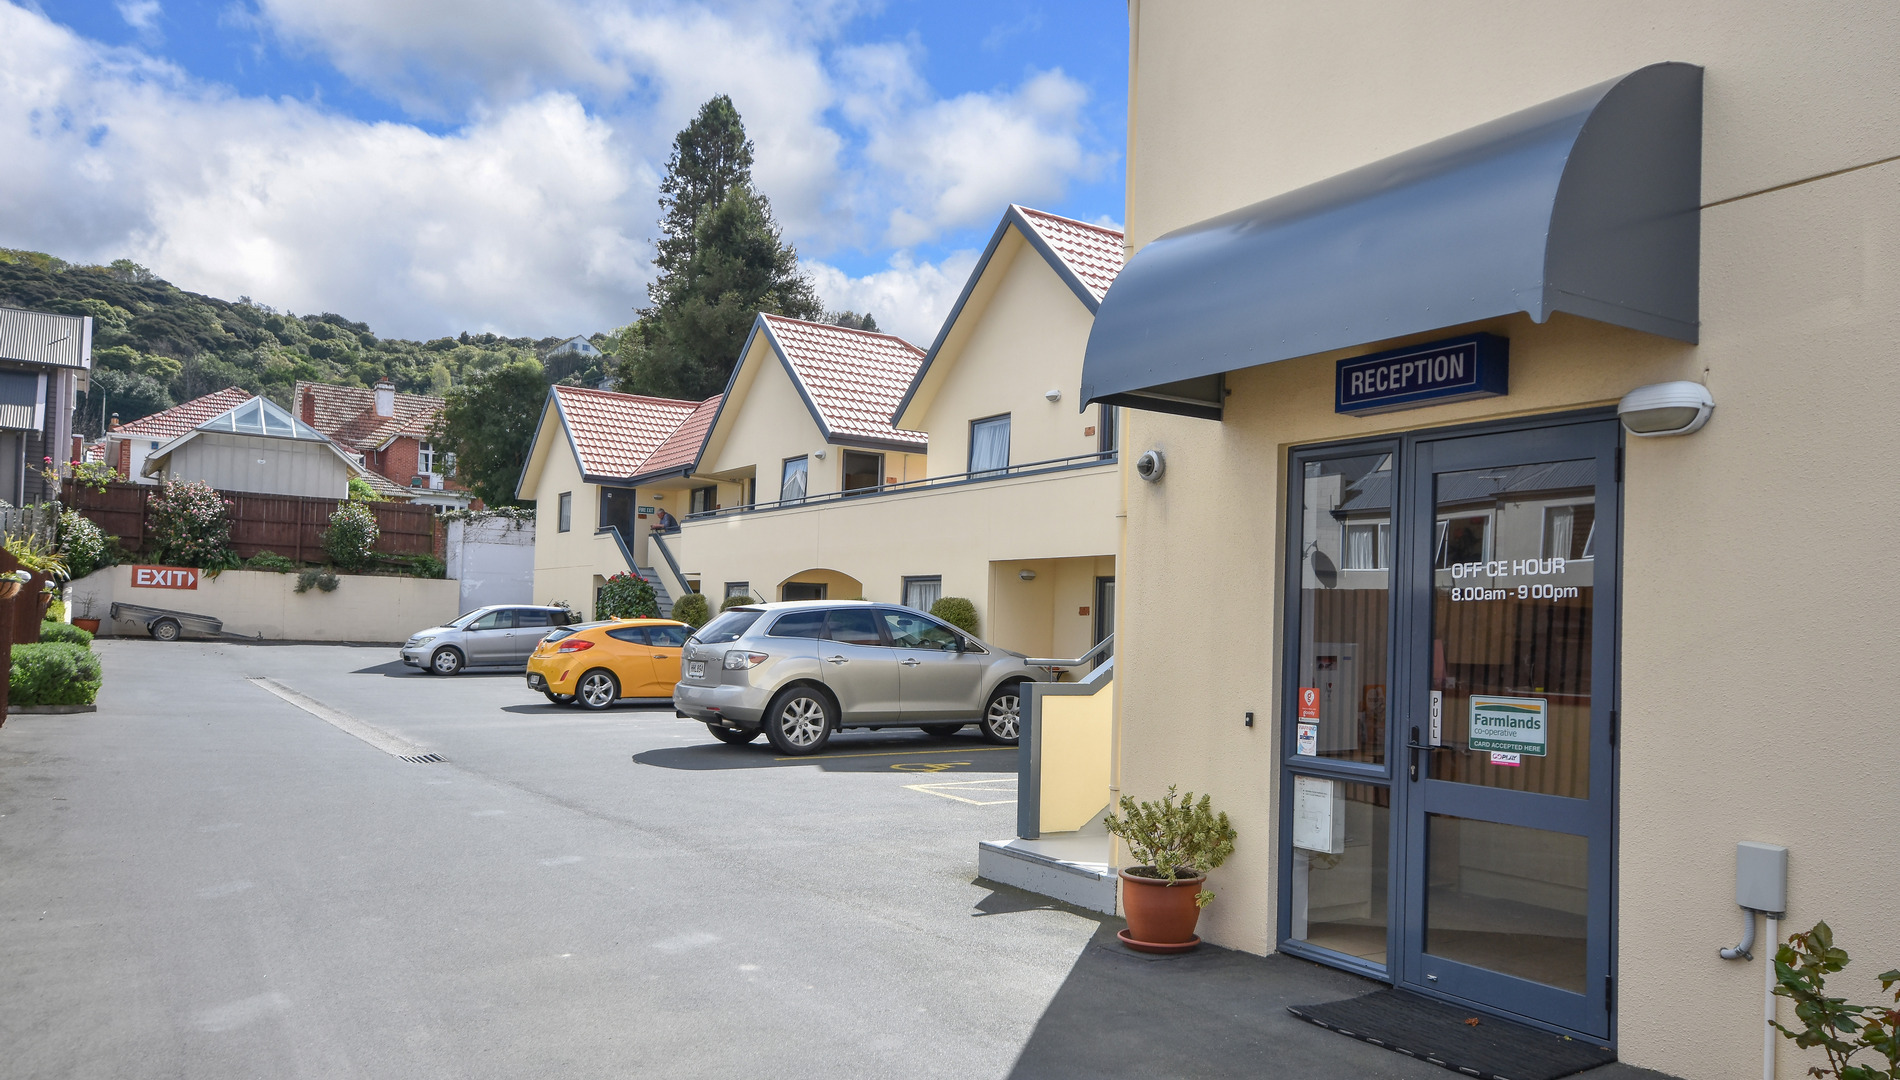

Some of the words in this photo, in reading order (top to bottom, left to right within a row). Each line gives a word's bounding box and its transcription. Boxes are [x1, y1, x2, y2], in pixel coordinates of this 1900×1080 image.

[1351, 352, 1464, 396] RECEPTION
[1451, 560, 1508, 579] OFFCE
[1513, 557, 1566, 576] HOUR
[137, 568, 187, 587] EXIT
[1451, 586, 1506, 602] 8.00am
[1474, 713, 1541, 730] Farmlands
[1474, 728, 1518, 738] co-operative
[1491, 742, 1523, 751] ACCEPTED
